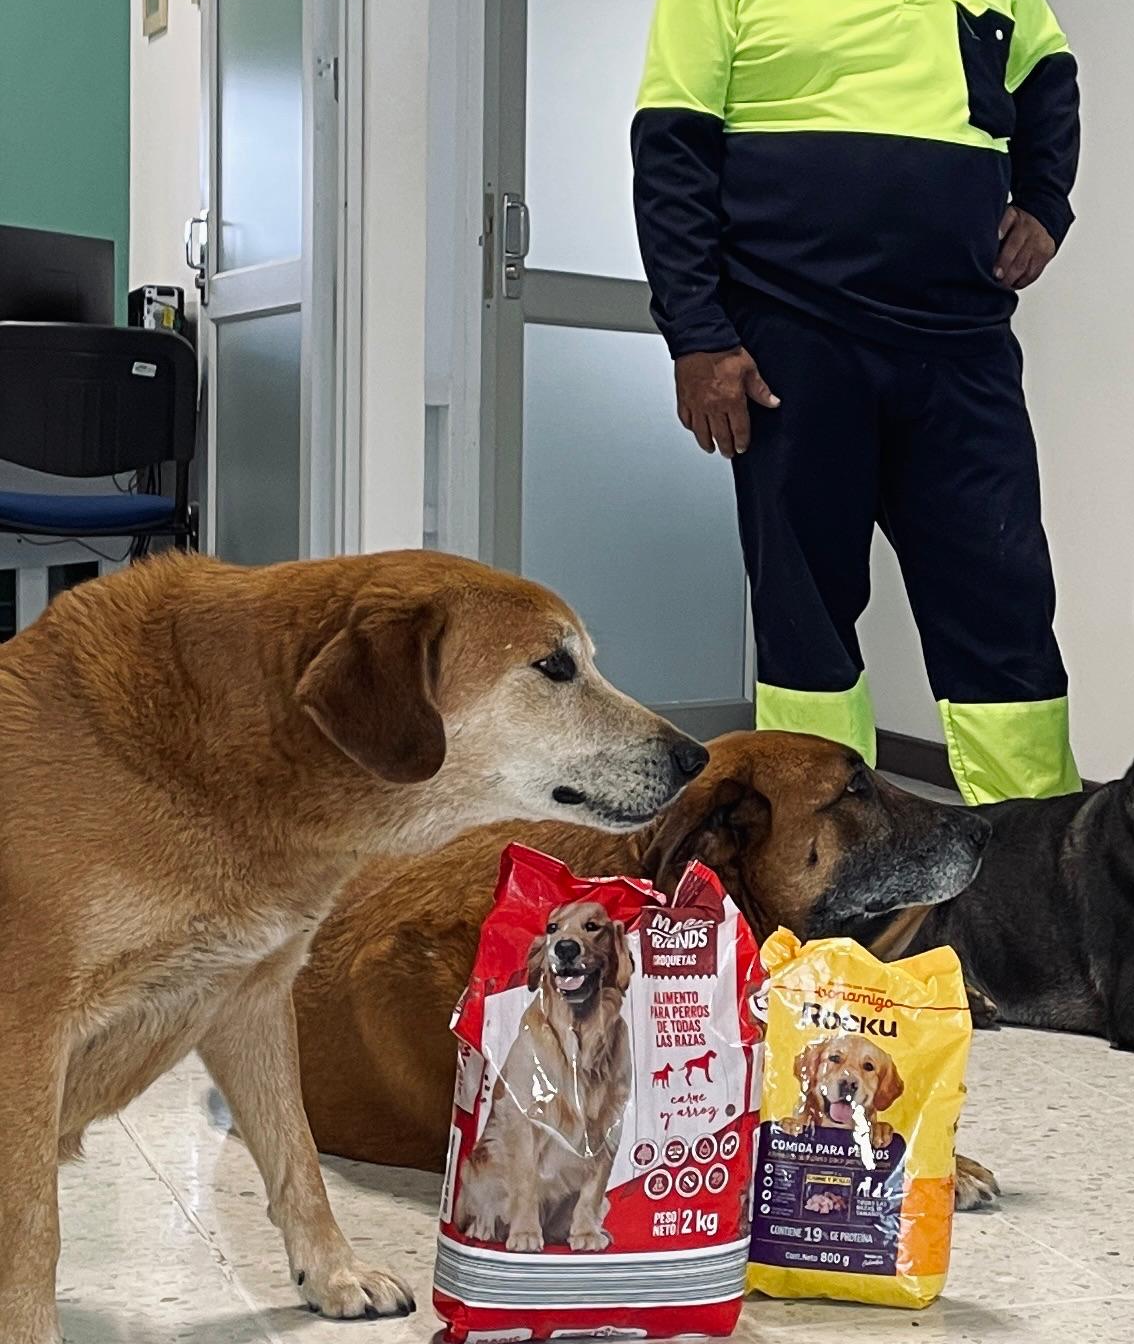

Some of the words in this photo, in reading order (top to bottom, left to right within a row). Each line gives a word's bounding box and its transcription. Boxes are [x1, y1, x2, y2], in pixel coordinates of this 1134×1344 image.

[654, 991, 699, 1004] ALIMENTO
[650, 1005, 671, 1019] PARA
[672, 1004, 710, 1018] PERROS
[657, 1020, 669, 1033] DE
[670, 1019, 701, 1033] TODAS
[656, 1034, 673, 1047] LAS
[674, 1033, 706, 1046] RAZAS
[670, 1093, 707, 1104] carne
[677, 1106, 719, 1123] arroz
[771, 1139, 813, 1154] COMIDA
[816, 1143, 845, 1156] PARA
[653, 1211, 677, 1224] PESO
[681, 1209, 693, 1234] 2
[696, 1209, 718, 1236] kg
[652, 1223, 676, 1237] NETO
[820, 1252, 840, 1264] 800
[843, 1256, 850, 1267] g
